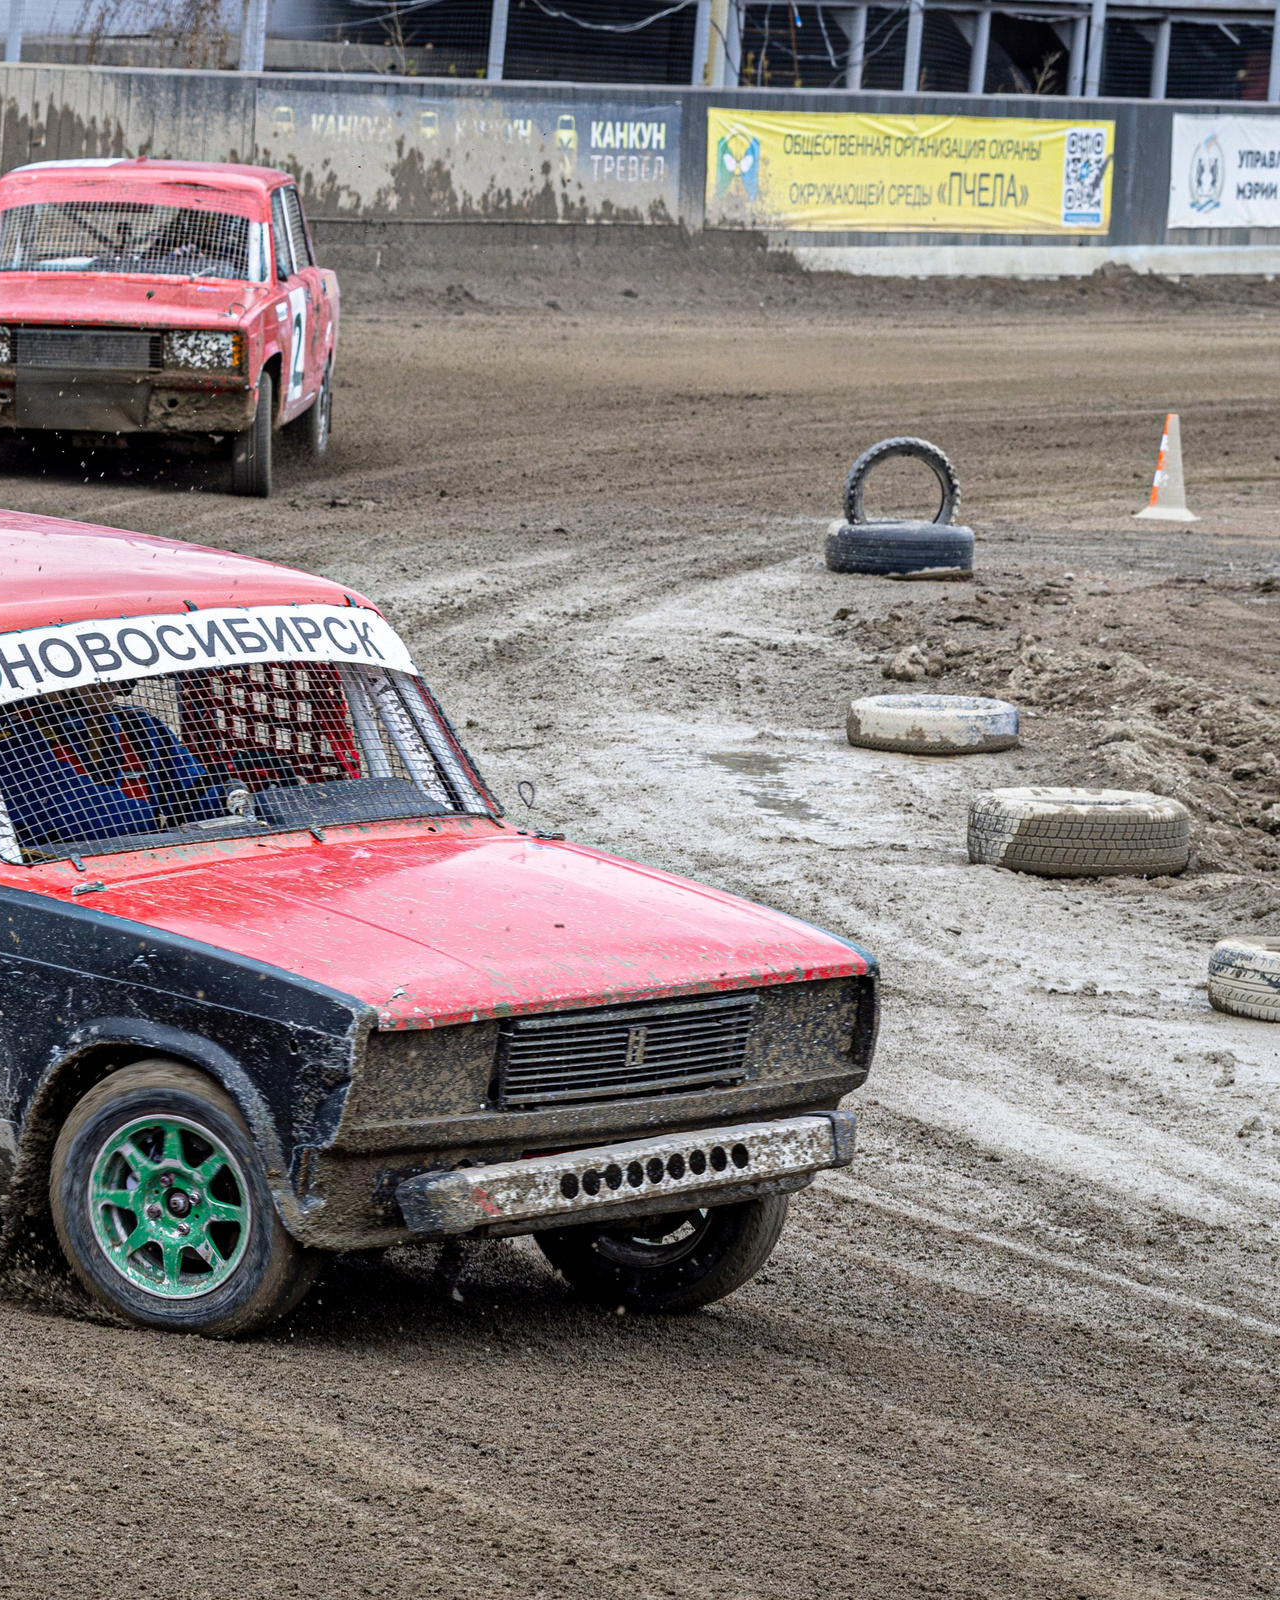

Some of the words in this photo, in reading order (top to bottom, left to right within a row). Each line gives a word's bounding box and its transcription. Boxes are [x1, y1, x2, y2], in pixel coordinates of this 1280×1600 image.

[590, 120, 666, 150] КАНКУН
[783, 133, 892, 160] ОБЩЕСТВЕННАЯ
[894, 136, 985, 163] ОРГАНИЗАЦИЯ
[988, 138, 1042, 161] ОХРАНЫ
[589, 154, 666, 183] ТРЕВЕЛ
[789, 180, 885, 210] ОКРУЖАЮЩЕЙ
[888, 183, 933, 209] СРЕДЫ
[937, 171, 1029, 207] «ПЧЕЛА»
